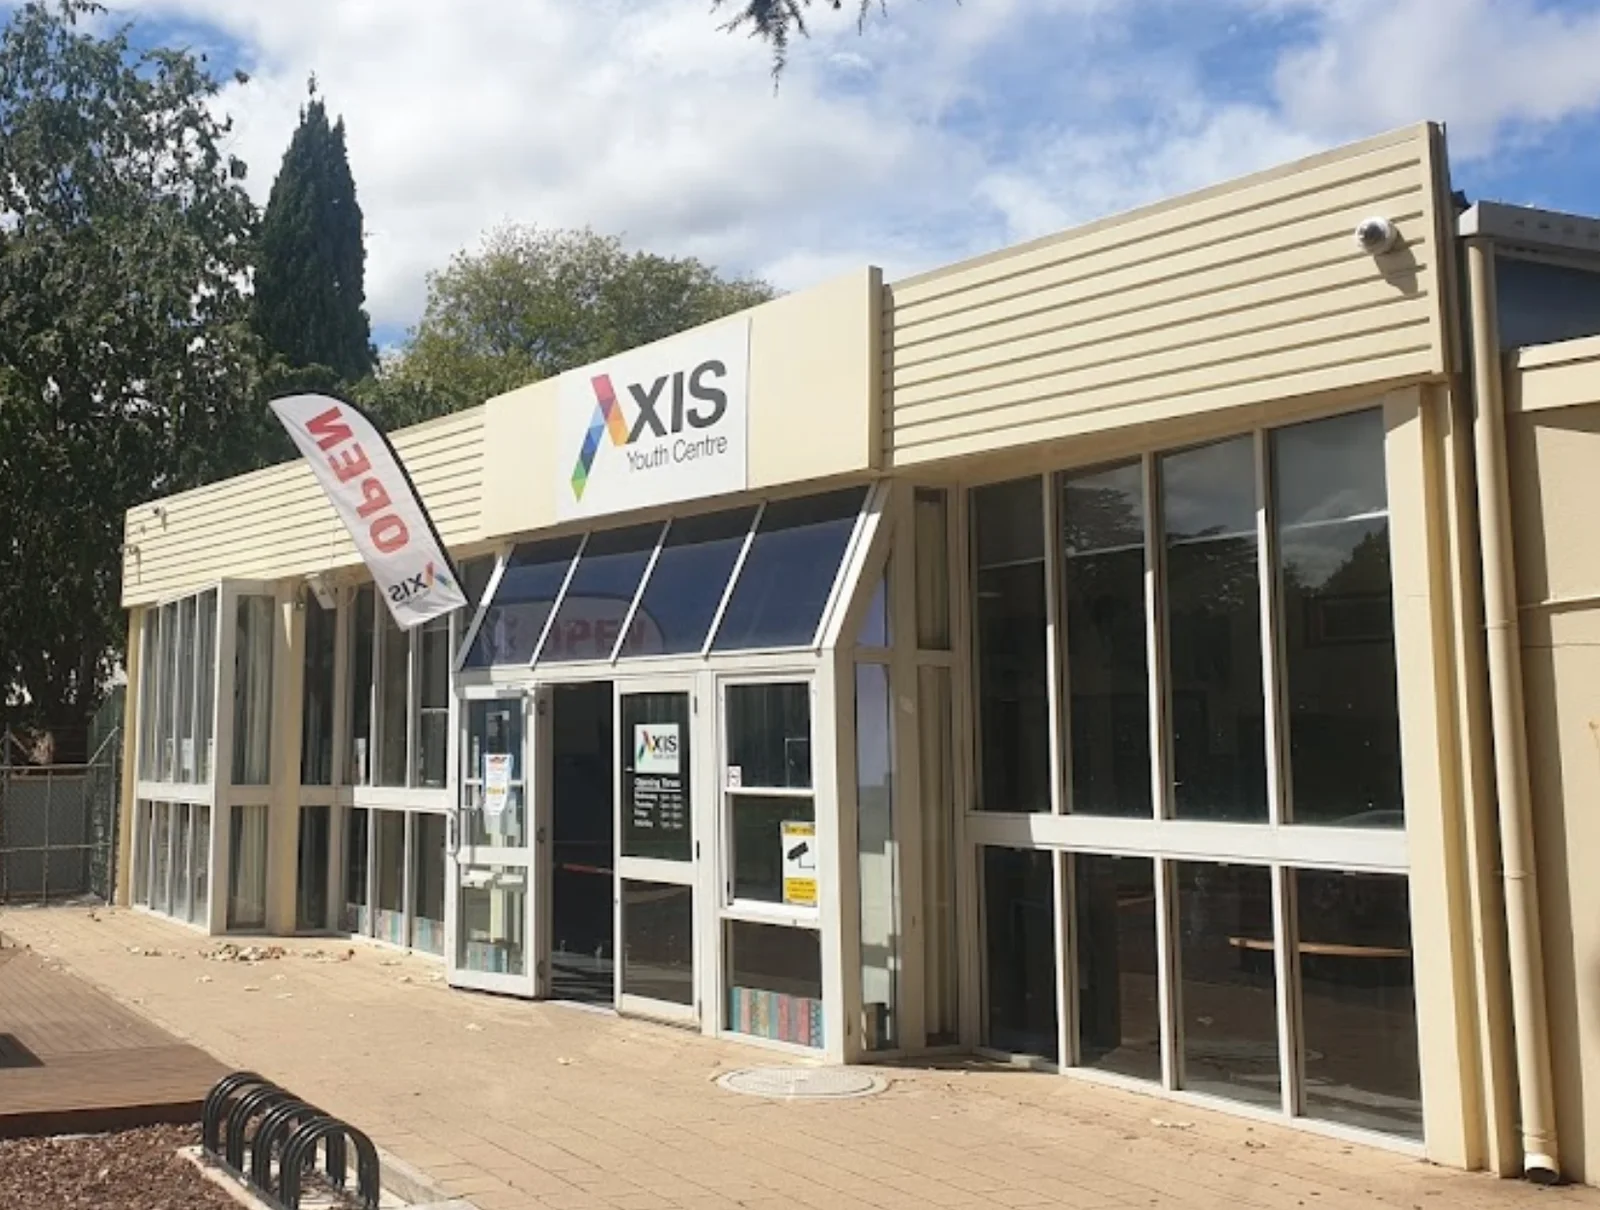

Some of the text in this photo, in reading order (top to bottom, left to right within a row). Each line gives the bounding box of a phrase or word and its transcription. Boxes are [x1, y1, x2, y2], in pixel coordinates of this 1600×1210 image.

[571, 360, 728, 502] AXIS
[627, 435, 728, 471] Youth Centre
